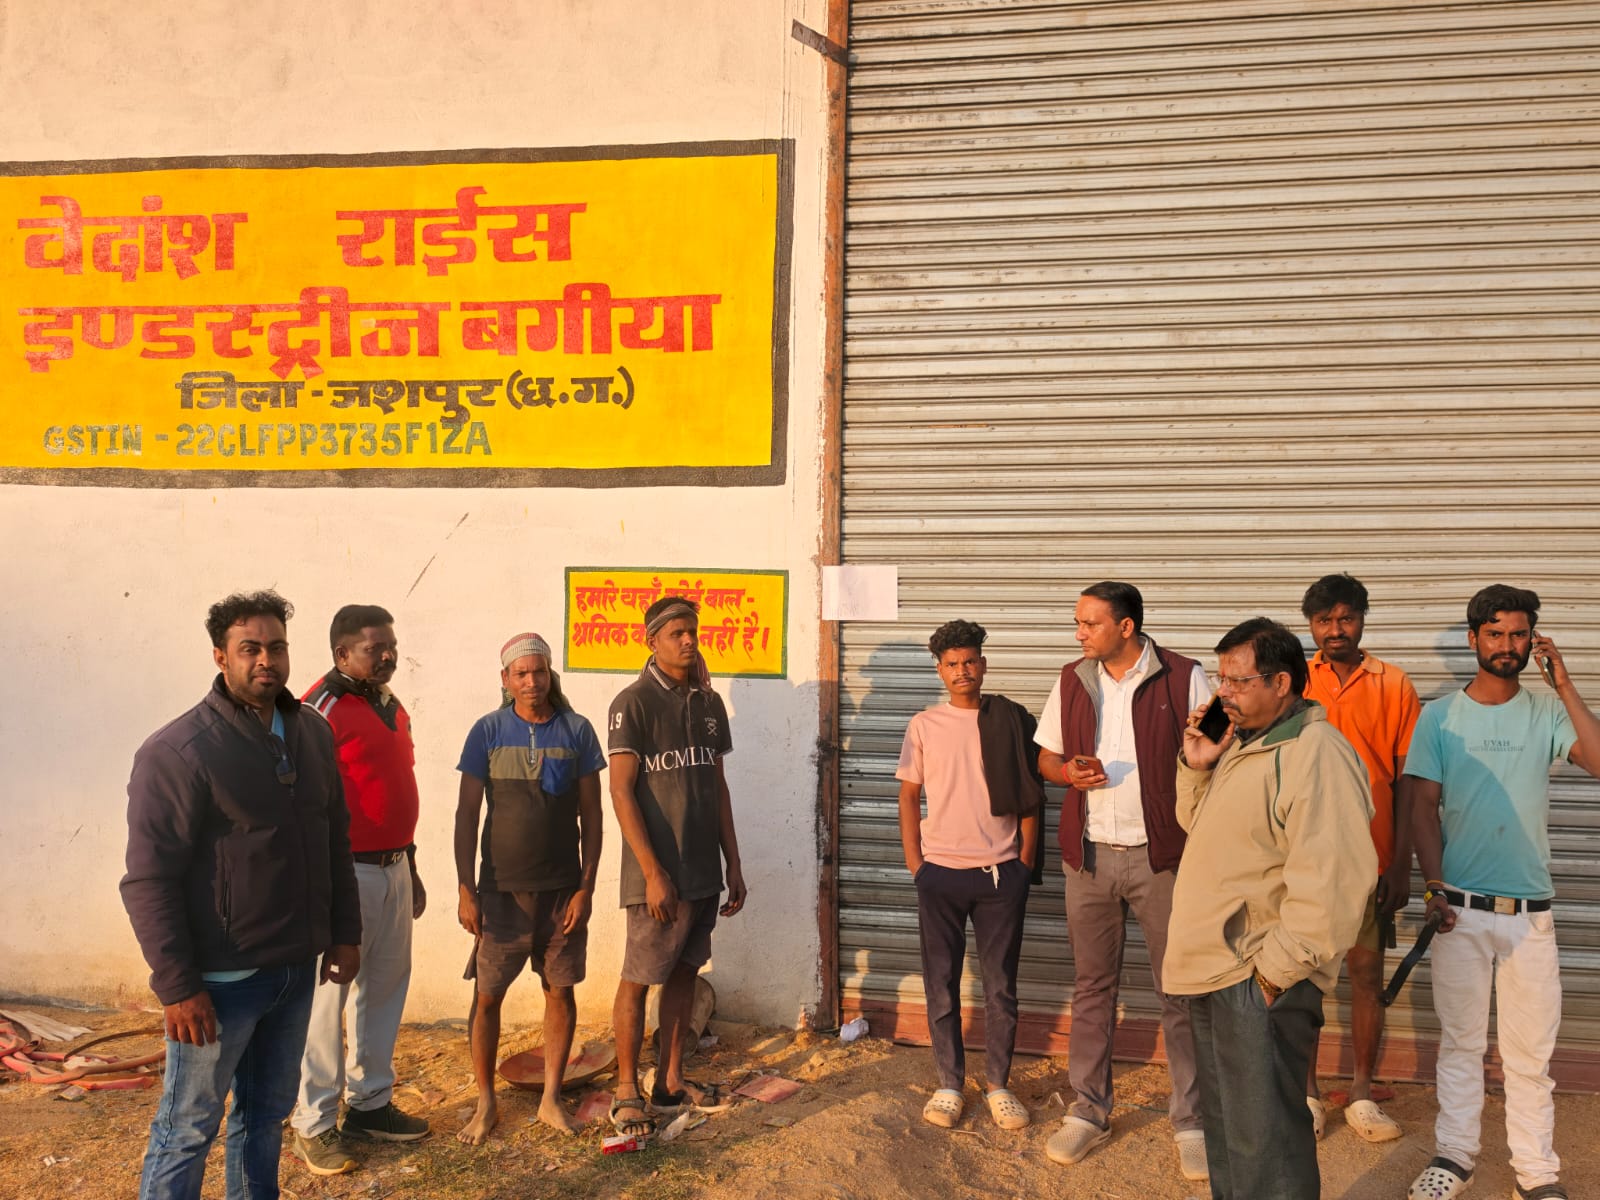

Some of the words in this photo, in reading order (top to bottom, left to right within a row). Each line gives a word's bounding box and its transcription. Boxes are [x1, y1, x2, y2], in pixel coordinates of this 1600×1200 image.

[17, 195, 248, 282] वेदांश
[336, 186, 587, 276] राईस
[460, 283, 722, 356] बगीया
[44, 424, 142, 456] GSTIN
[576, 579, 619, 618] हमारे
[573, 614, 628, 648] श्रमिक
[700, 617, 739, 657] नहीं
[610, 712, 622, 730] 19
